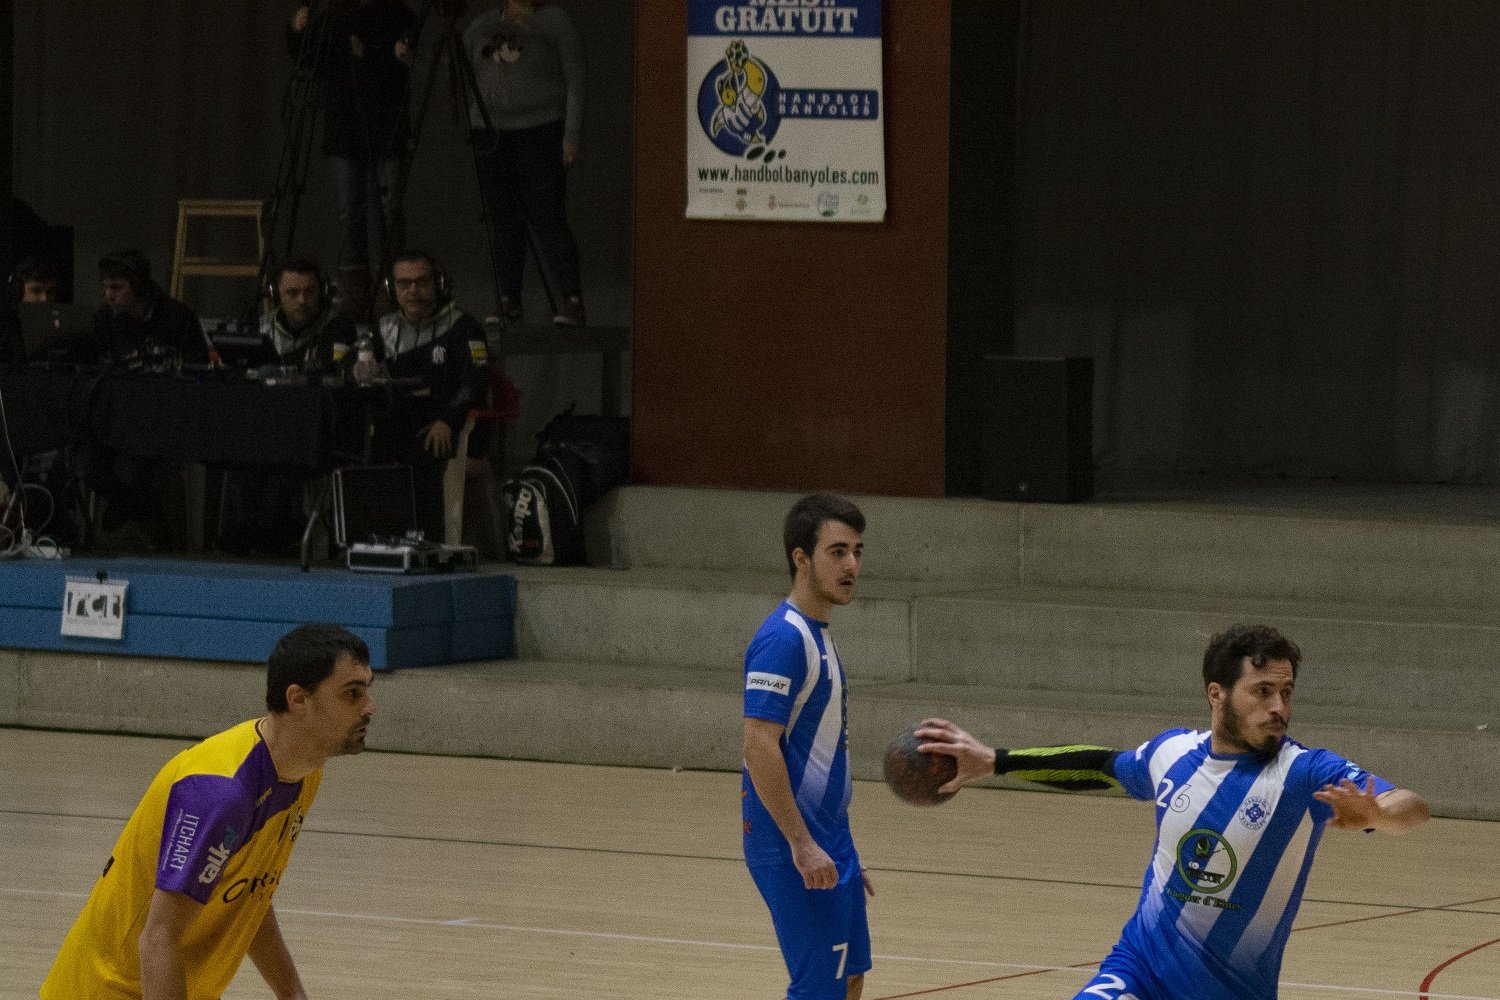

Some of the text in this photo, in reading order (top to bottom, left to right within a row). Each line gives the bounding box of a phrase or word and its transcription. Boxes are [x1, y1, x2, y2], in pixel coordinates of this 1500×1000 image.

[715, 5, 859, 33] GRATUIT
[778, 93, 872, 105] HANDBOL
[778, 104, 871, 116] BANYOLES
[698, 164, 880, 188] www.handbolbanyoles.com
[751, 678, 786, 690] PRIVAT
[1156, 778, 1191, 813] 26
[170, 814, 200, 871] ITCHART
[832, 942, 849, 980] 7
